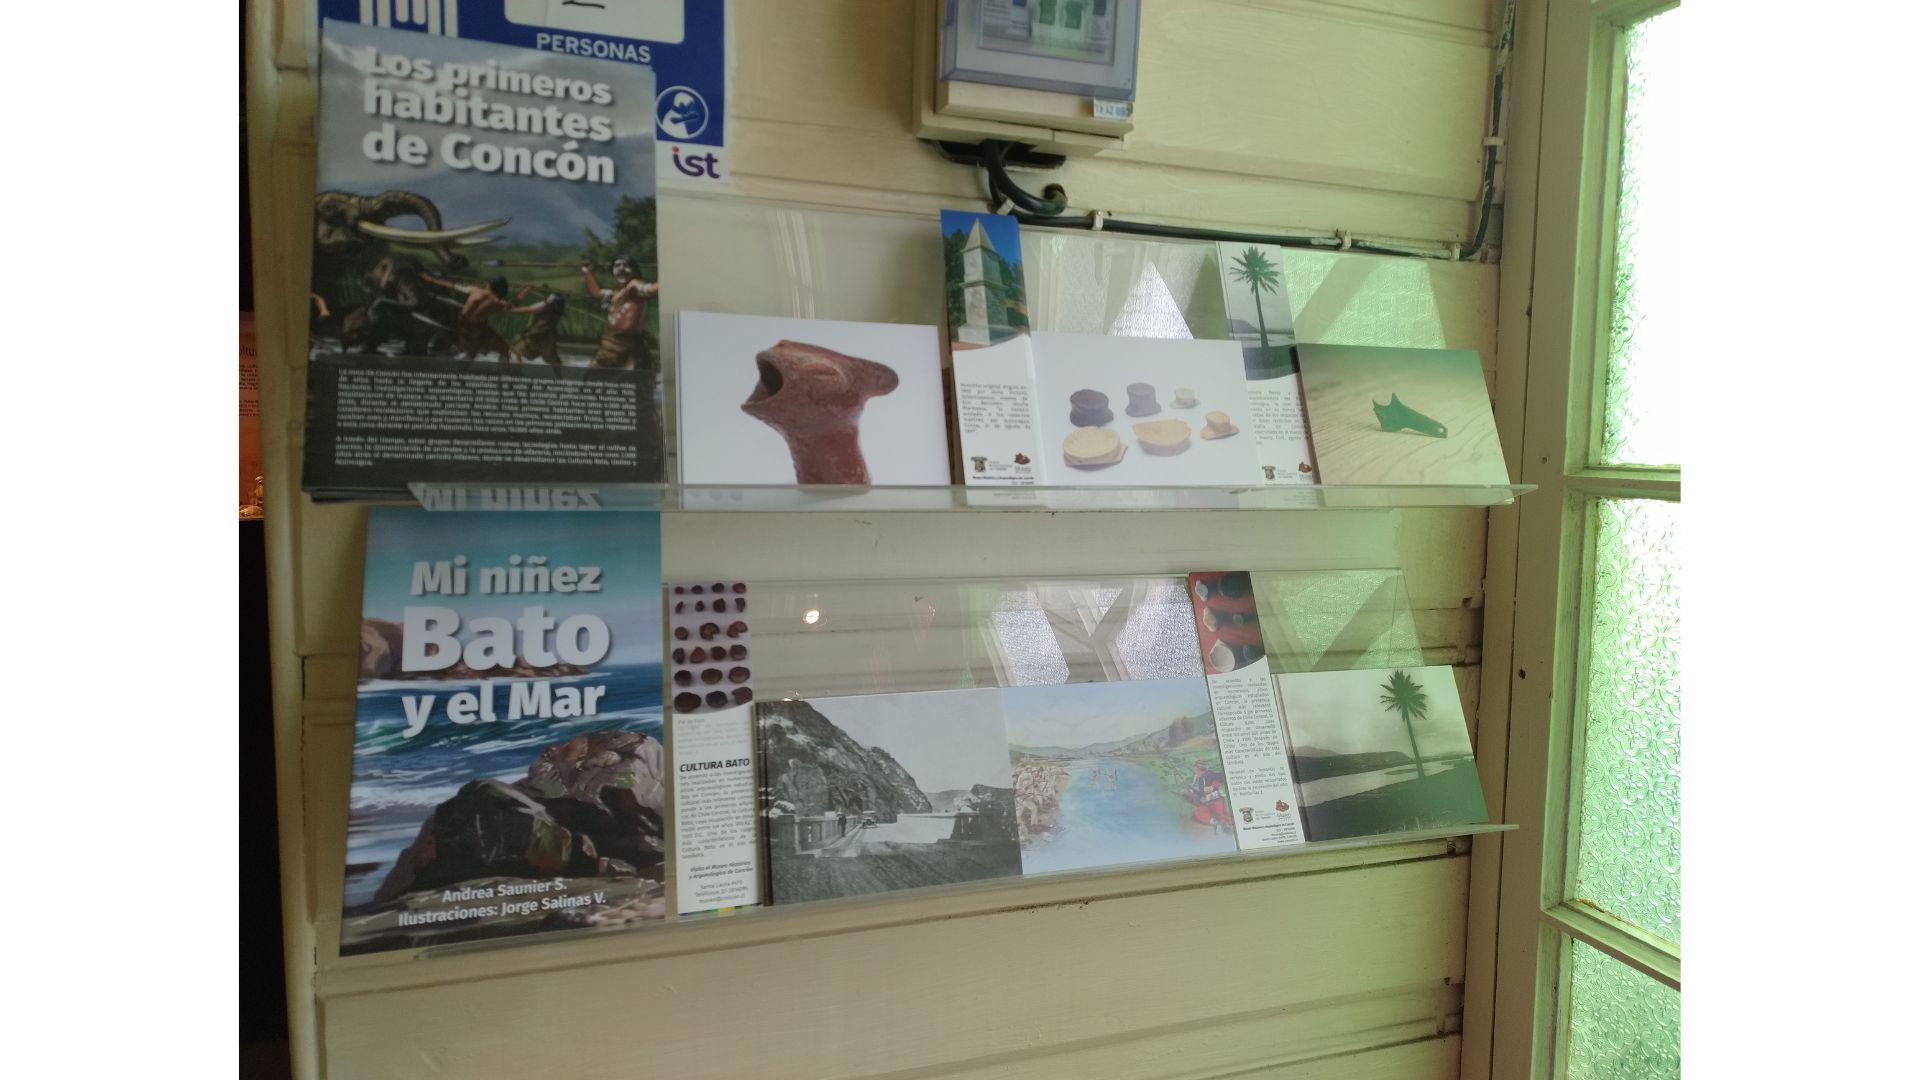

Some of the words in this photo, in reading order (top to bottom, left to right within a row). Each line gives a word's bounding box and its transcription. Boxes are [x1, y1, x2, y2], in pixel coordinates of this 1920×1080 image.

[536, 32, 651, 63] PERSONAS
[367, 46, 434, 82] Los
[444, 61, 613, 105] primeros
[364, 80, 613, 143] habitantes
[363, 122, 429, 166] de
[441, 133, 615, 184] Concón
[671, 146, 720, 179] ist
[411, 555, 467, 596] Mi
[480, 555, 602, 594] niñez
[402, 606, 611, 672] Bato
[401, 695, 436, 739] y
[447, 679, 497, 725] el
[508, 681, 606, 720] Mar
[680, 761, 723, 772] CULTURA
[726, 758, 750, 767] BATO
[399, 906, 498, 927] Ilustraciones:
[501, 900, 538, 917] Jorge
[542, 895, 592, 910] Salinas
[595, 892, 606, 905] V.
[442, 886, 494, 904] Andrea
[497, 880, 552, 898] Saunier
[555, 877, 567, 891] S.
